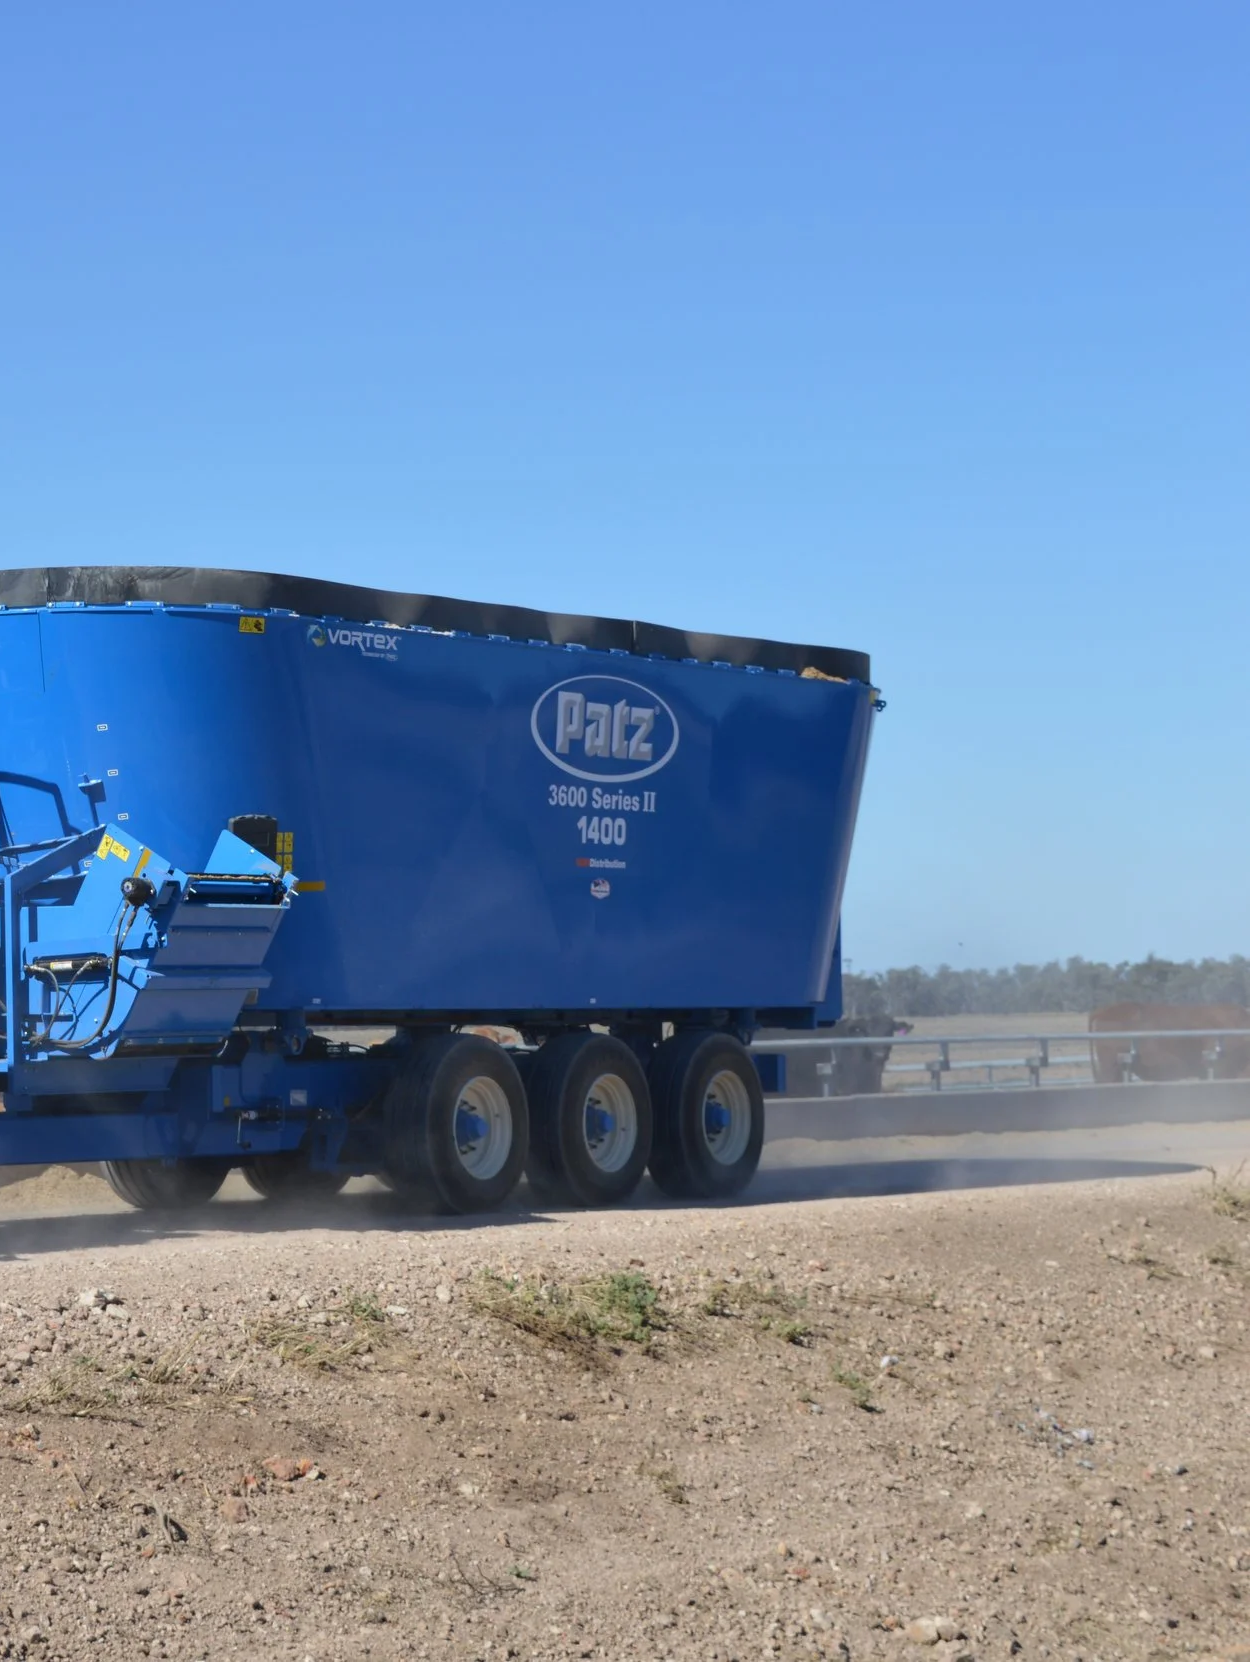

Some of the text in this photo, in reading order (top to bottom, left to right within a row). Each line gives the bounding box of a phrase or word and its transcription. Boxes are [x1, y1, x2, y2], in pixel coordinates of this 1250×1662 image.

[327, 628, 399, 652] VORTEX
[555, 690, 655, 761] Patz
[548, 784, 657, 812] 3600 Series II
[577, 815, 627, 846] 1400
